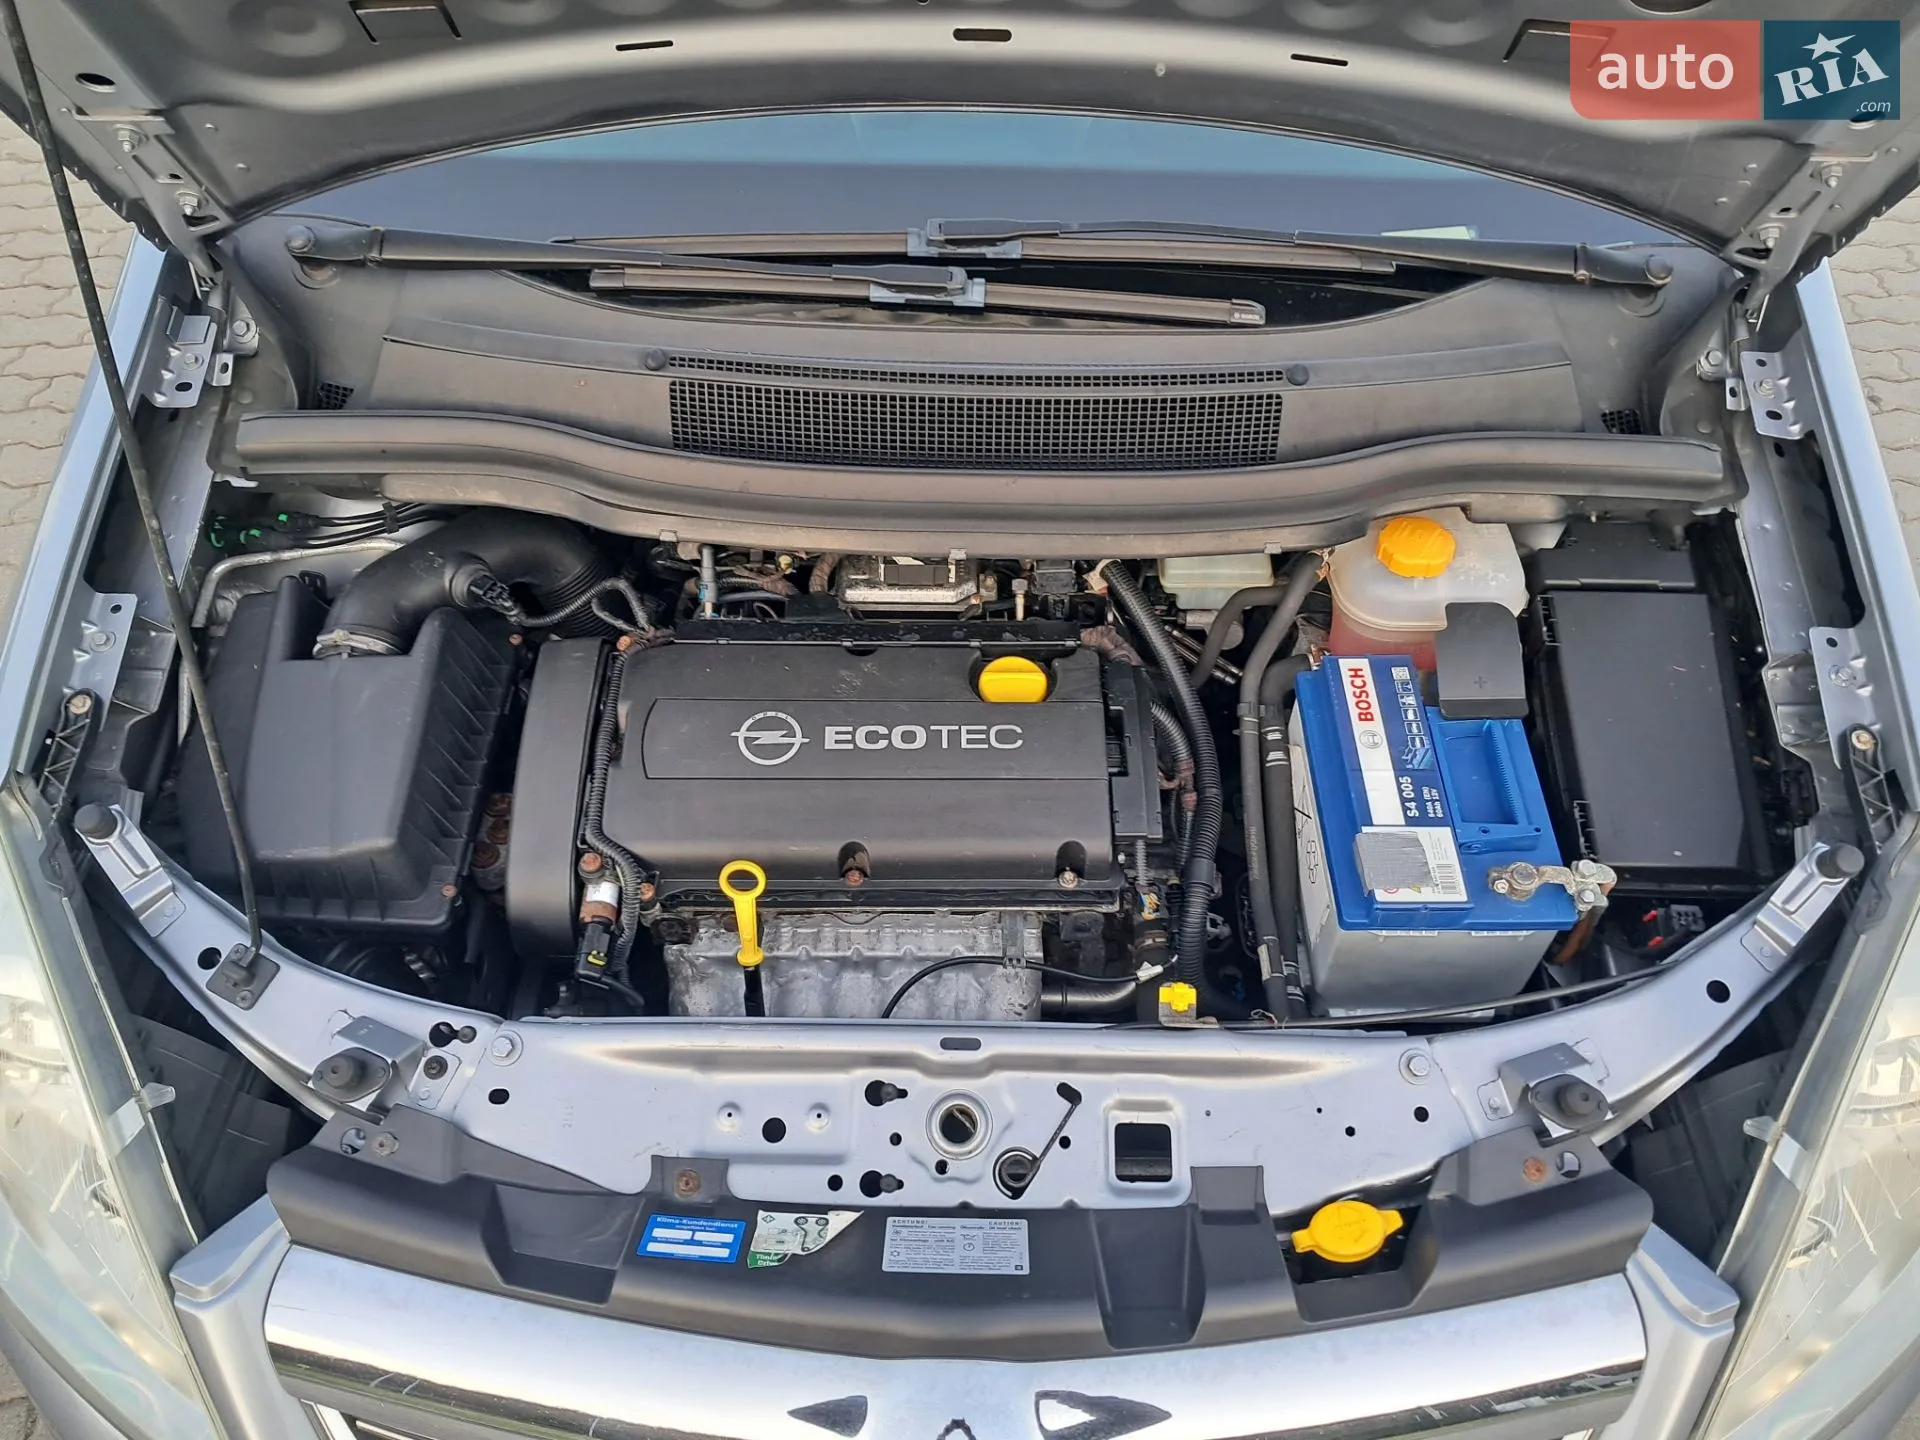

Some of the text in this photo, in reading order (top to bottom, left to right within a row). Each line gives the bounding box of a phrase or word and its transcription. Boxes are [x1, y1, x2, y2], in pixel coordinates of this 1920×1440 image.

[1347, 668, 1375, 722] BOSCH
[823, 724, 1024, 750] ECOTEC
[1398, 775, 1420, 817] S4 005
[1430, 787, 1440, 800] 12V
